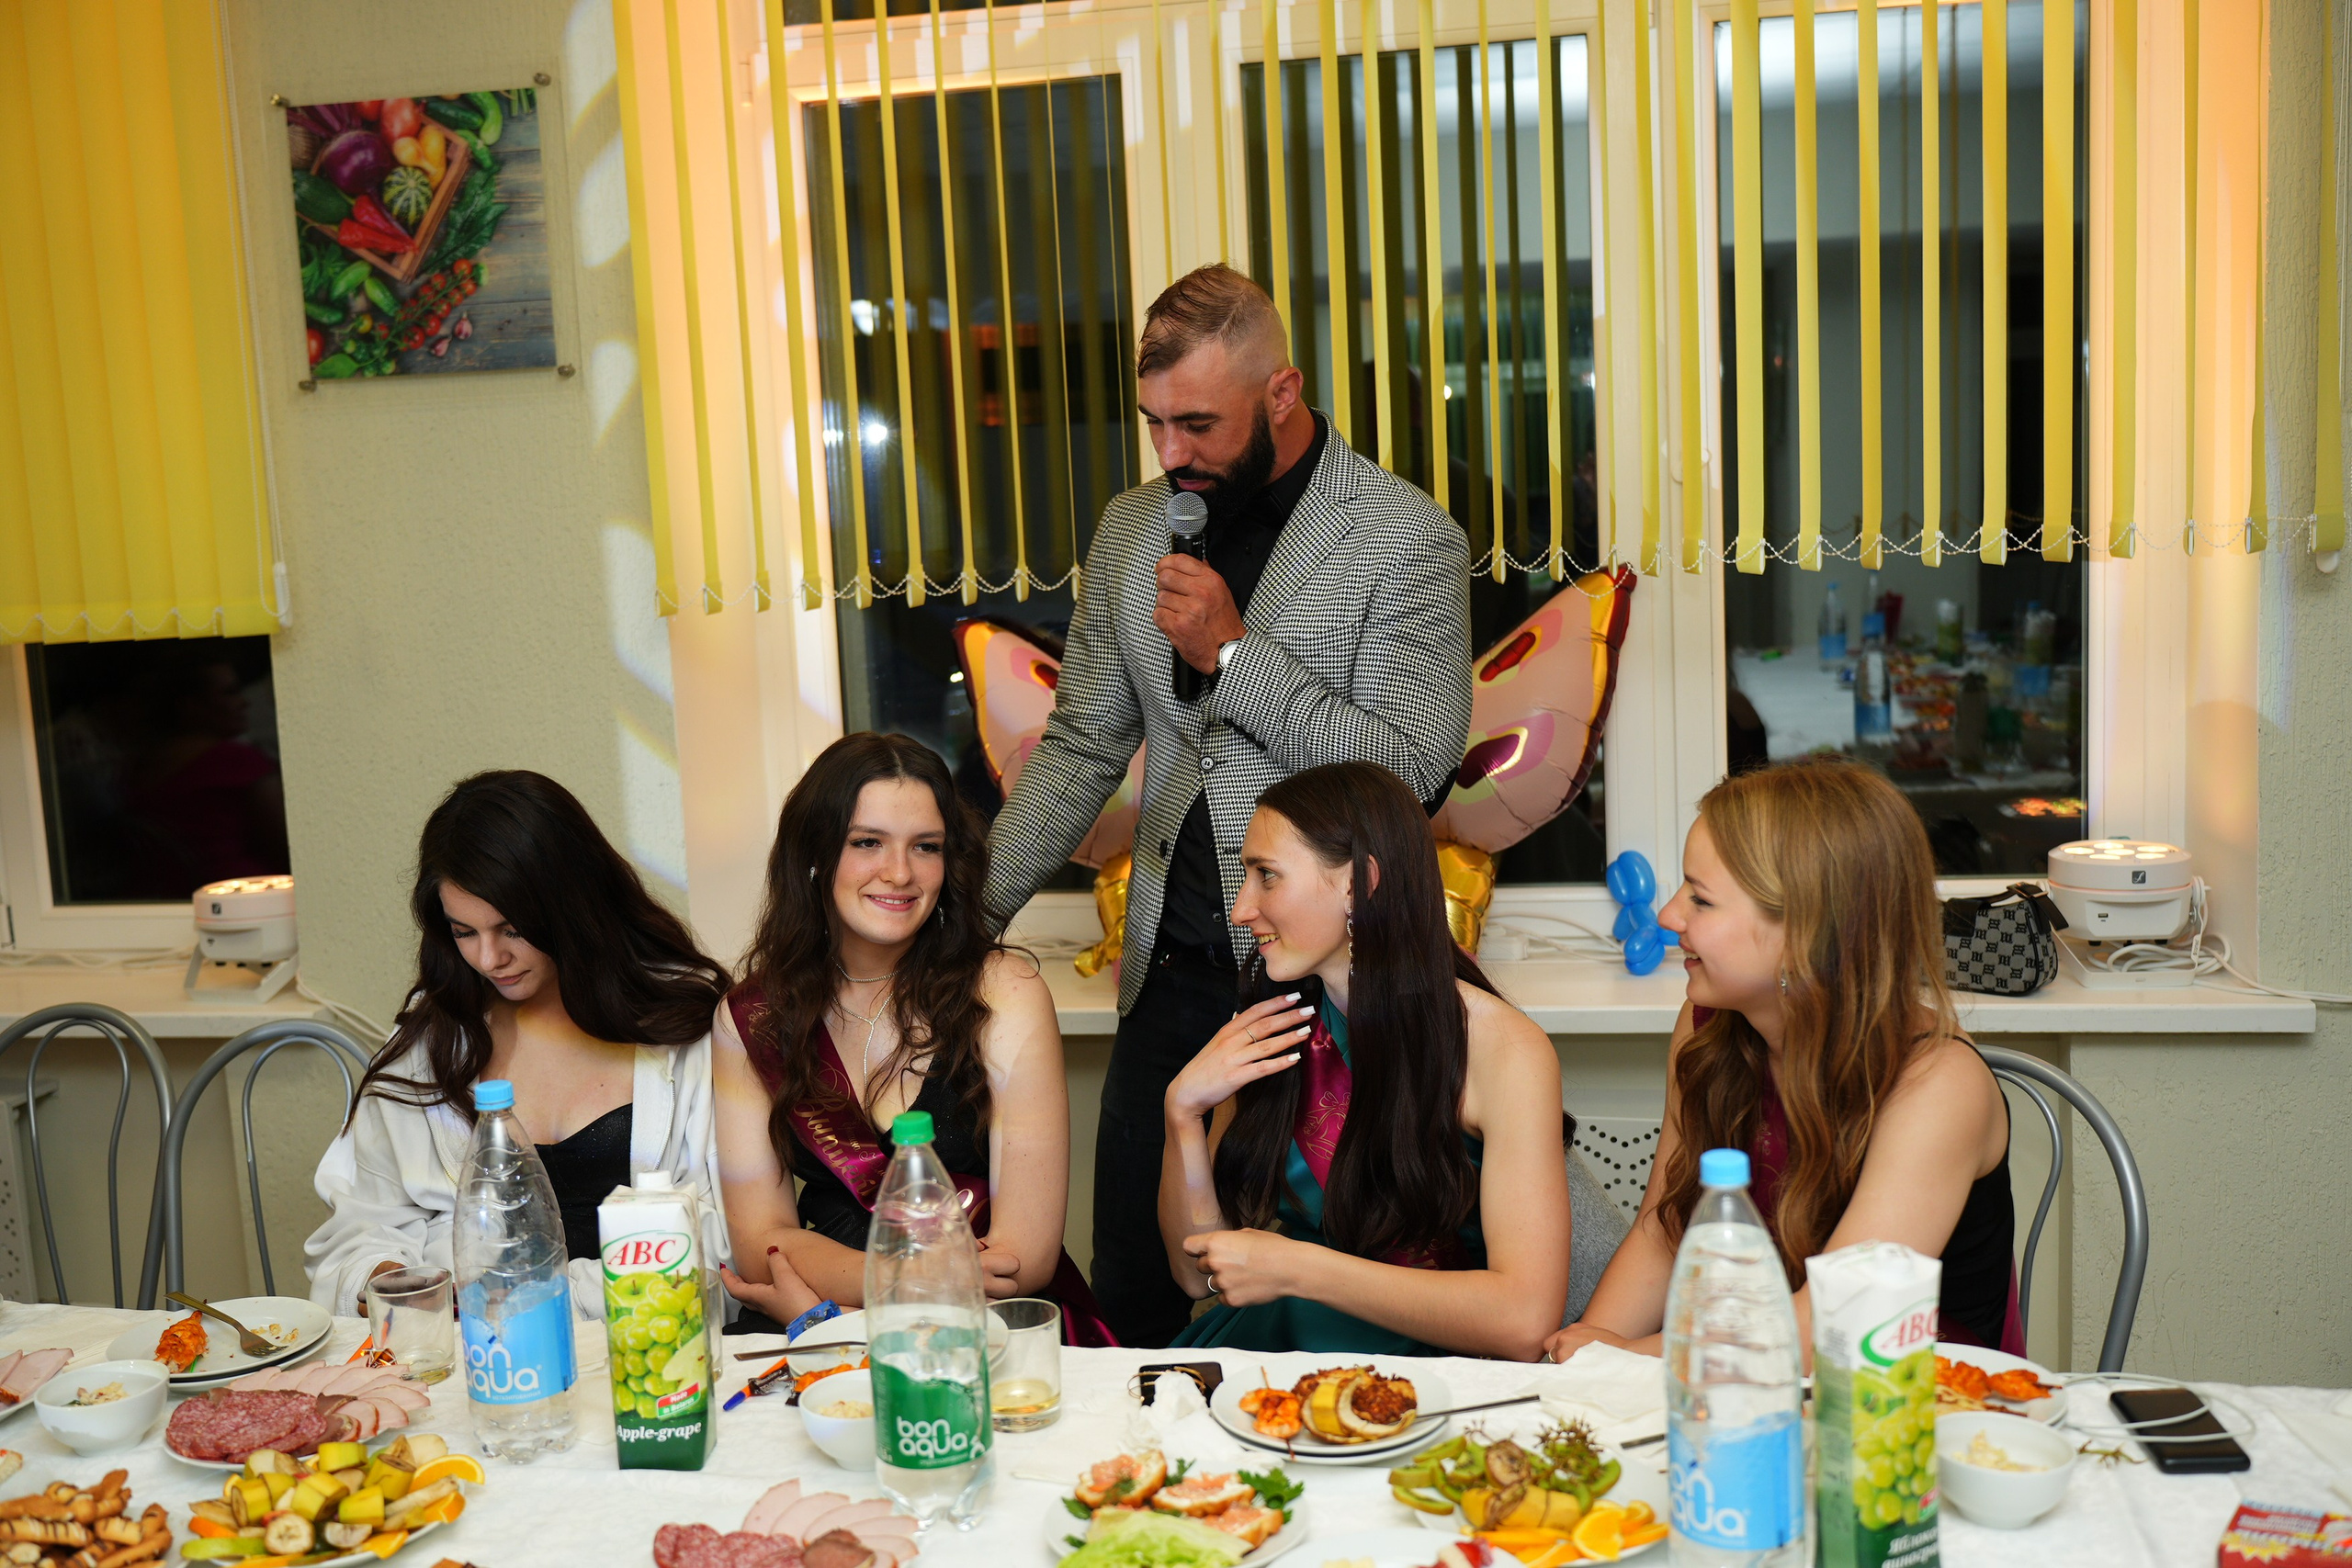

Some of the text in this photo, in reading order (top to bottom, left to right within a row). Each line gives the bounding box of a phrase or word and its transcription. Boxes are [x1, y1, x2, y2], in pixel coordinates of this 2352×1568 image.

[606, 1239, 676, 1266] ABC
[617, 1422, 702, 1443] Apple-grape
[897, 1416, 950, 1438] bon
[1671, 1463, 1715, 1503] on
[1672, 1492, 1747, 1537] qua
